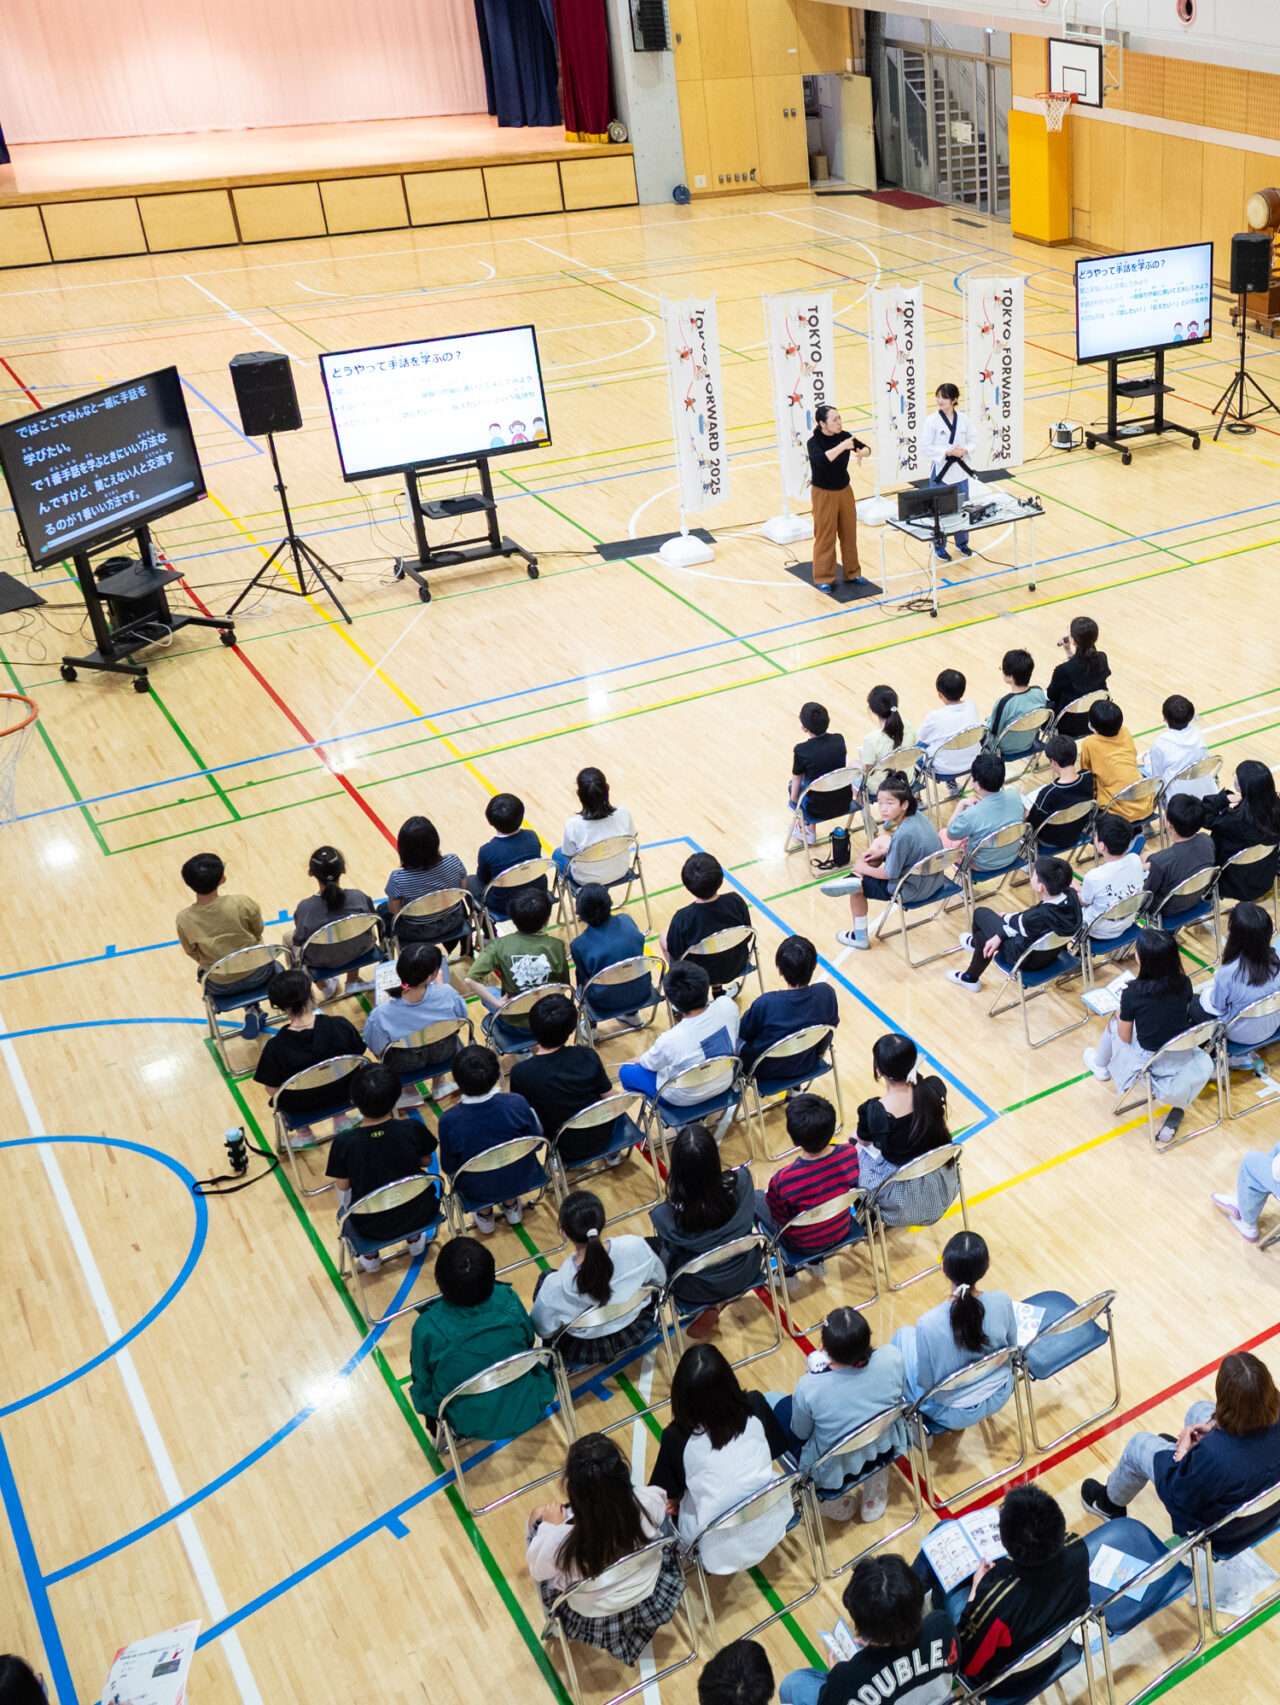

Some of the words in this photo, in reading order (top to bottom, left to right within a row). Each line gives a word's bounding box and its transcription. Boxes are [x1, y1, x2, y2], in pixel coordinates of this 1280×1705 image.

[807, 305, 822, 363] TOKYO
[904, 299, 915, 351] TOKYO
[1001, 288, 1013, 340] TOKYO
[905, 358, 917, 430] FORWARD
[1002, 347, 1012, 419] FORWARD
[23, 443, 72, 467] 学びたい。
[907, 436, 918, 470] 2025
[1001, 425, 1011, 460] 2025
[710, 458, 721, 496] 2025
